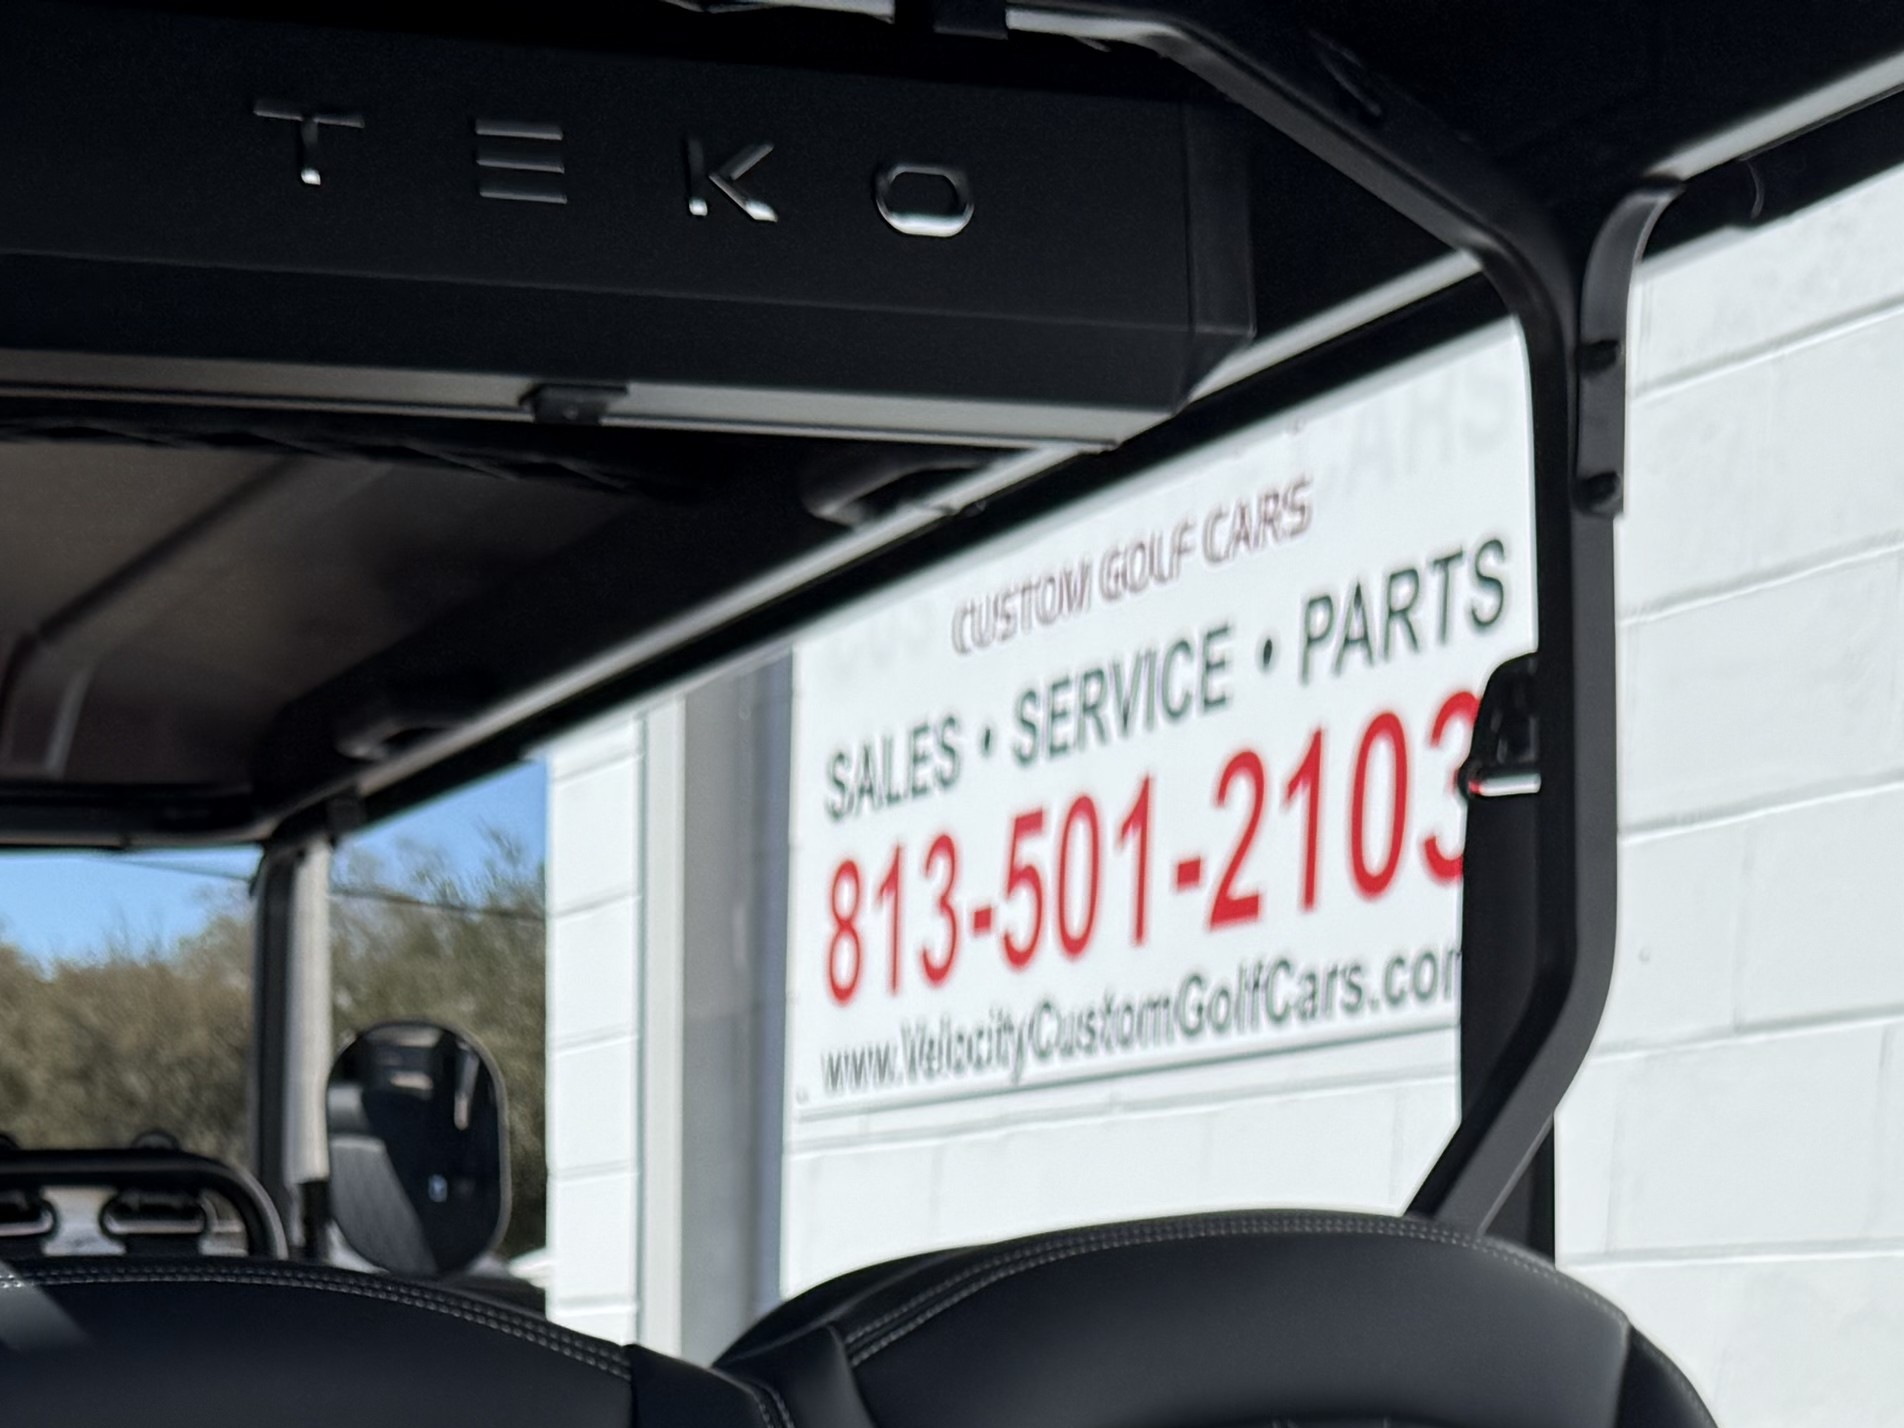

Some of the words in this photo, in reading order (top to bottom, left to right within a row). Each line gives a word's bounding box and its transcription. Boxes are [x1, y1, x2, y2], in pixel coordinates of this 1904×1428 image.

[252, 99, 975, 237] TEKO
[827, 713, 962, 822] SALES
[1013, 625, 1232, 768] SERVICE
[1301, 539, 1507, 684] PARTS
[952, 558, 1092, 655] CUSTOM
[1099, 519, 1196, 600] GOLF
[1202, 478, 1312, 566] CARS
[828, 691, 1481, 1006] 813-501-2103
